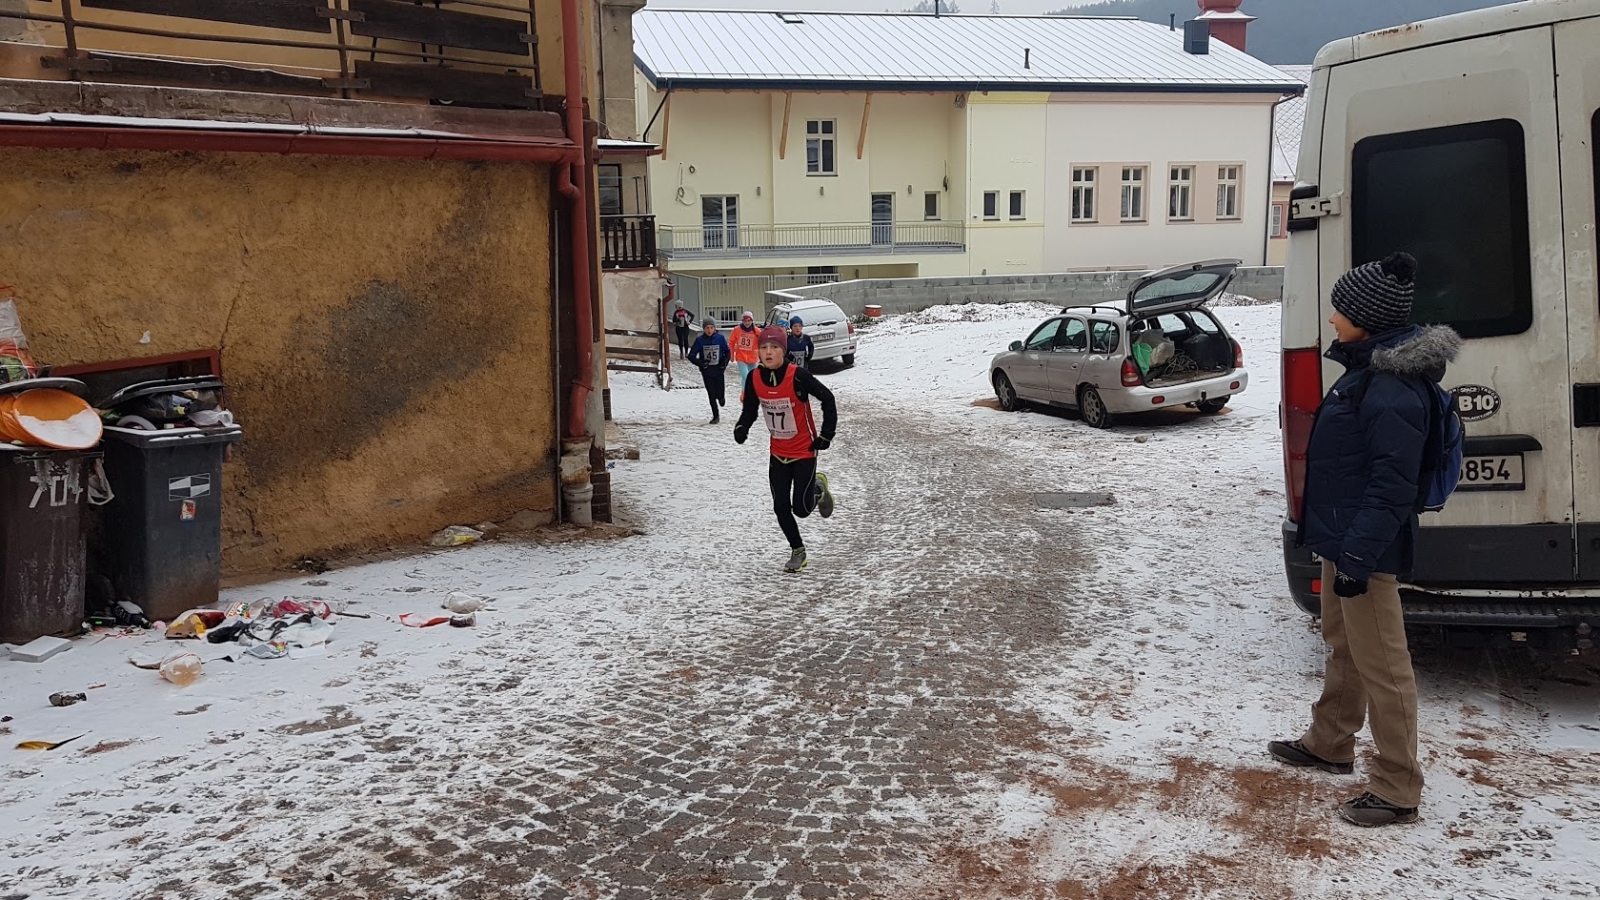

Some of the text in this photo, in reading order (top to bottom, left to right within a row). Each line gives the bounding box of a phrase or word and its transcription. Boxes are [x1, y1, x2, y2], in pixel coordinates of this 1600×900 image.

[741, 338, 751, 347] 83
[707, 351, 718, 361] 45
[1458, 395, 1495, 411] B10
[767, 411, 786, 430] 77
[1459, 459, 1510, 481] 854
